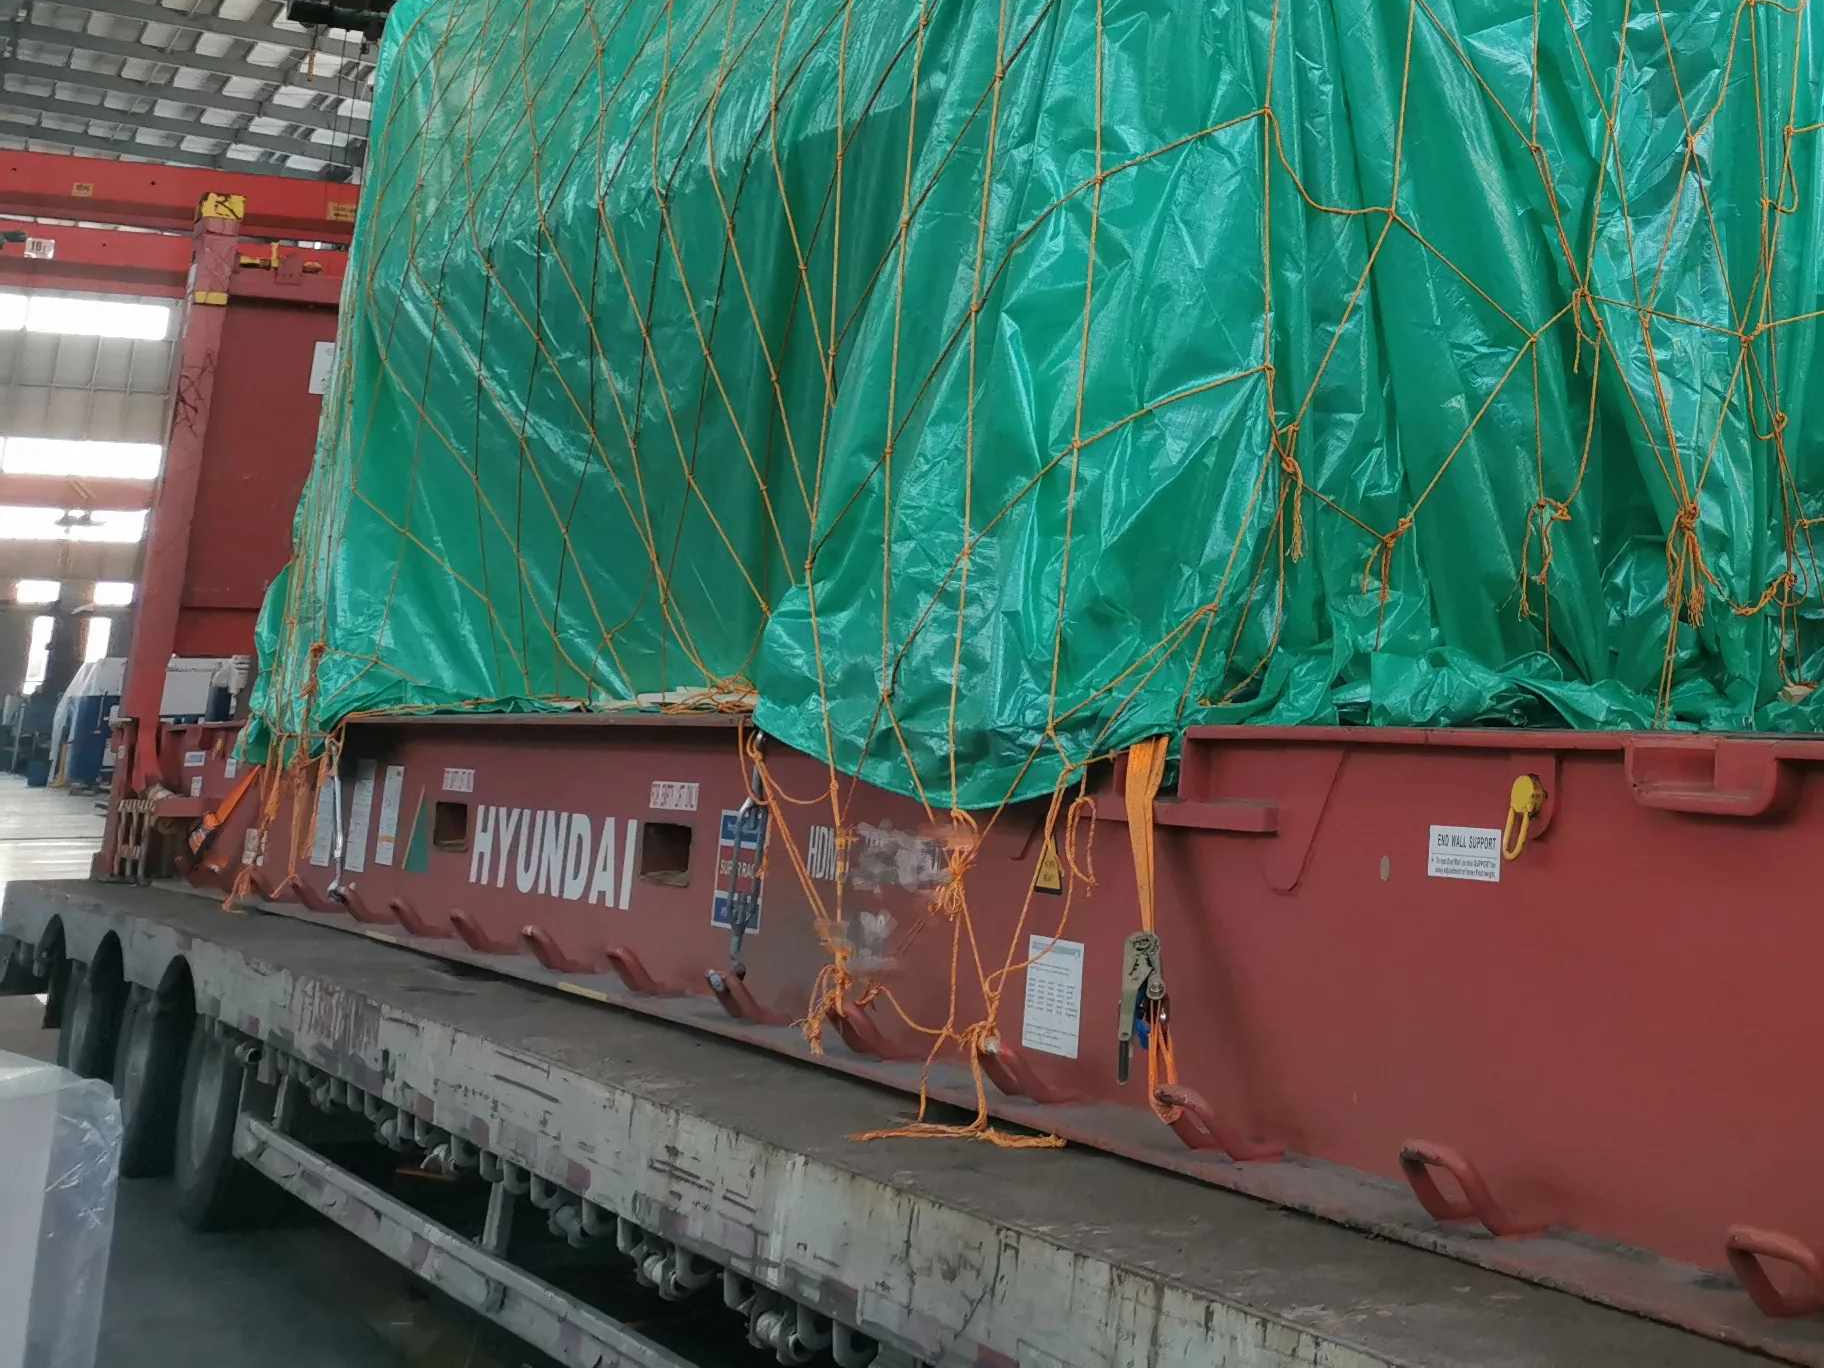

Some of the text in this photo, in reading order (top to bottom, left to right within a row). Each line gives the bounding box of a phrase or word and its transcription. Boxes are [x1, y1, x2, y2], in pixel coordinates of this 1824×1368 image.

[469, 804, 638, 910] HYUNDAI
[807, 825, 850, 882] HDM
[1437, 833, 1496, 850] END WALL SUPPORT
